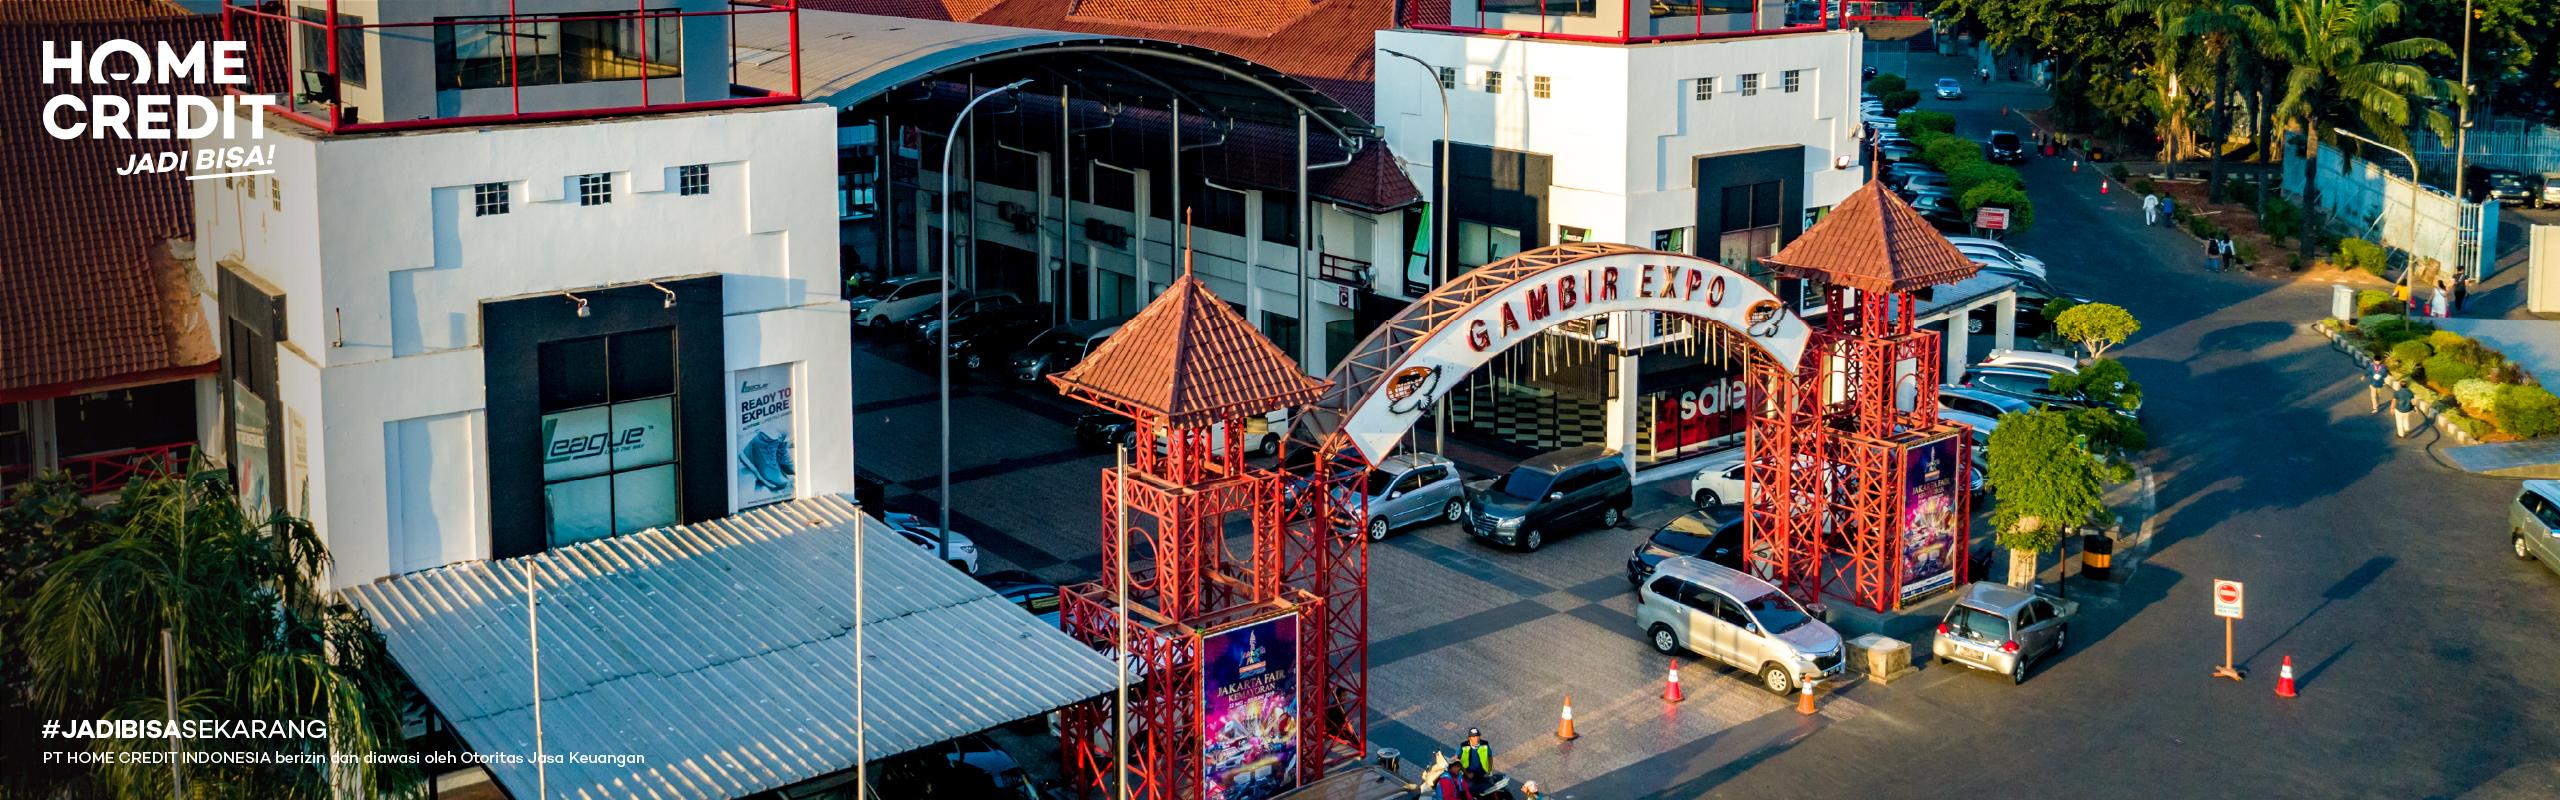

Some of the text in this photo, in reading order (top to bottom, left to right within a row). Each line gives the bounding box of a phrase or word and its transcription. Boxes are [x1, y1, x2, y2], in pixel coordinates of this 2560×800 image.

[1467, 264, 1726, 352] GAMBIR EXPO
[741, 387, 792, 412] READY TO
[742, 399, 790, 424] EXPLORE
[1681, 377, 1747, 420] sale
[1217, 676, 1263, 697] JAKARTA
[1264, 670, 1286, 684] FAIR
[1228, 682, 1276, 702] KEMAYORAN
